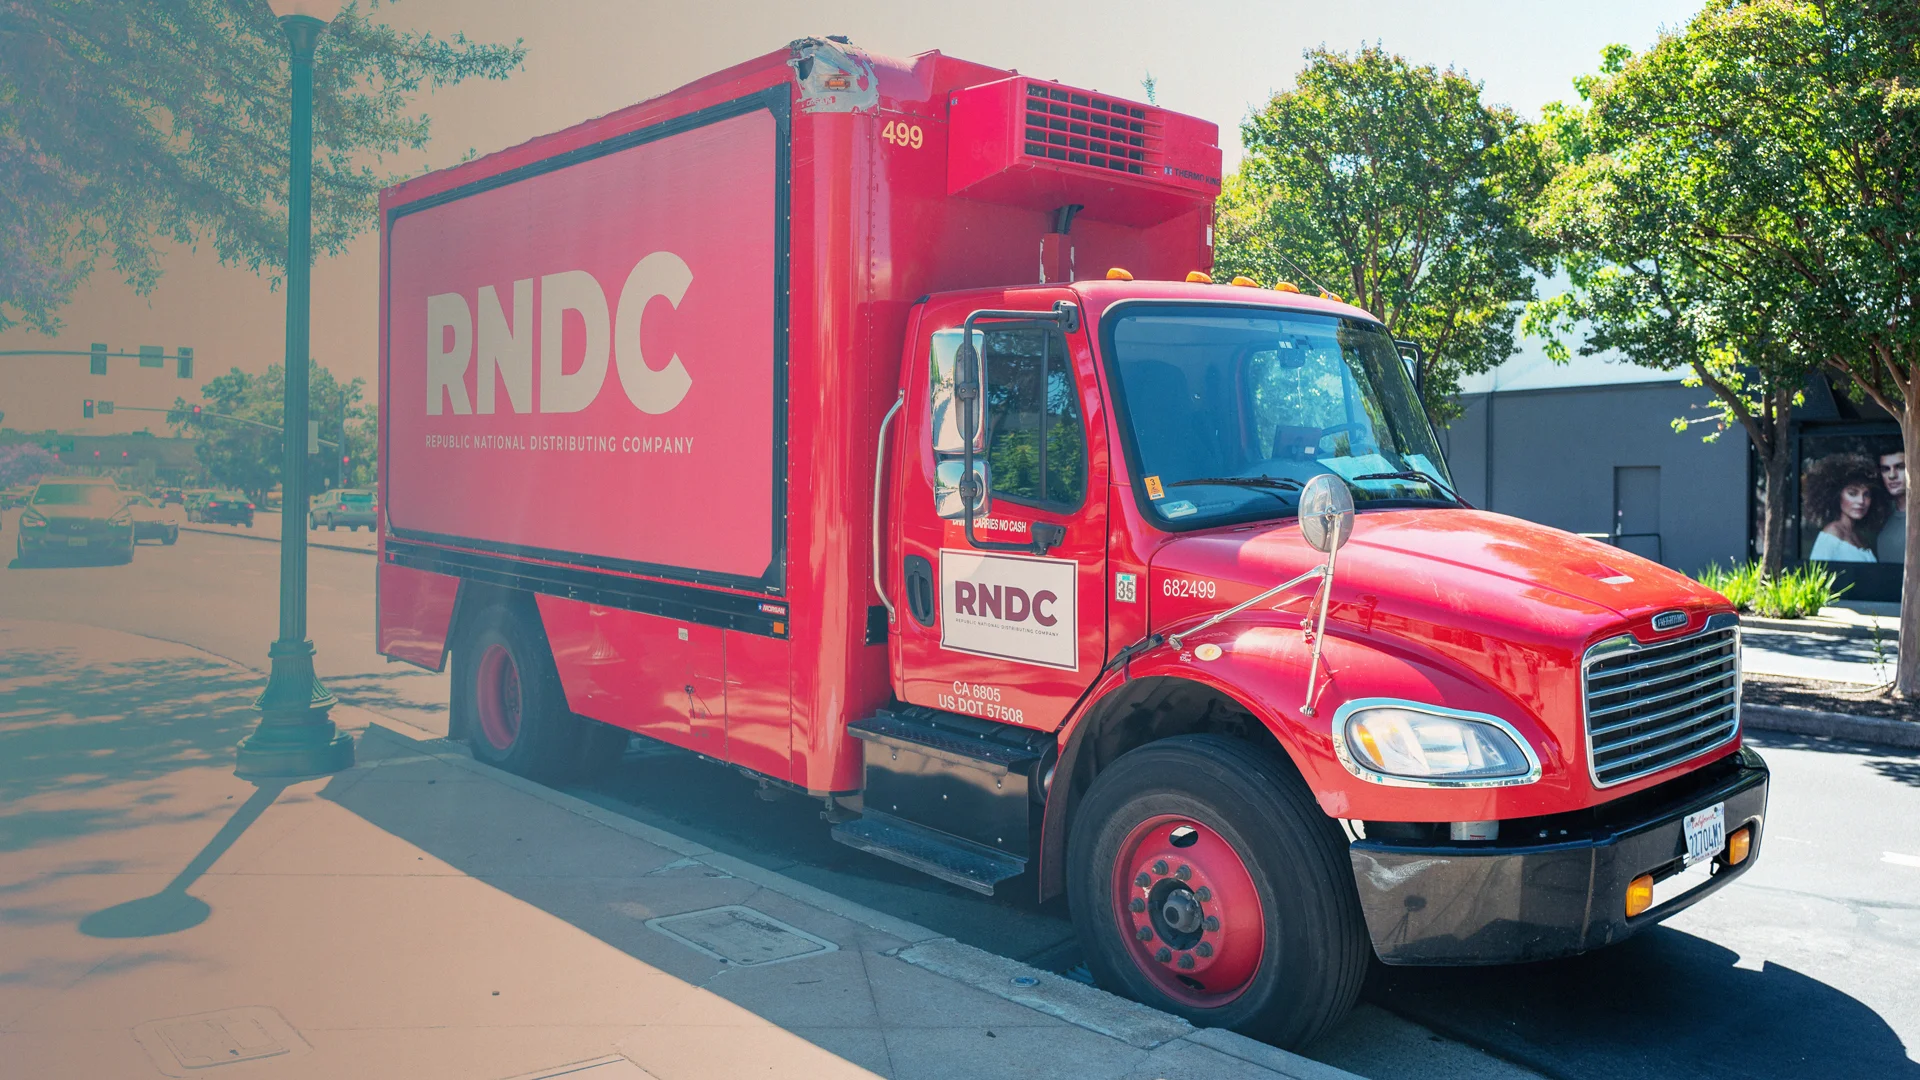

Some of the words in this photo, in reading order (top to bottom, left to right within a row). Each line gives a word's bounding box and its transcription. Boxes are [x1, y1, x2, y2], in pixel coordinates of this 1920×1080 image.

[882, 120, 923, 149] 499
[1174, 168, 1204, 182] THERMO
[426, 251, 694, 415] RNDC
[425, 434, 470, 449] REPUBLIC
[474, 435, 526, 450] NATIONAL
[530, 435, 616, 452] DISTRIBUTING
[622, 436, 694, 454] COMPANY
[973, 517, 999, 530] CARRIES
[999, 519, 1009, 532] NO
[1009, 521, 1027, 533] CASH
[1163, 578, 1216, 599] 682499
[955, 580, 1058, 627] RNDC
[955, 618, 977, 626] REPUBLIC
[978, 621, 1000, 629] NATIONAL
[1001, 625, 1034, 634] DISTRIBUTING
[1034, 629, 1059, 637] COMPANY
[953, 680, 971, 697] CA
[973, 684, 1001, 702] 6805
[938, 693, 956, 710] US
[958, 697, 984, 715] DOT
[987, 703, 1024, 724] 57508
